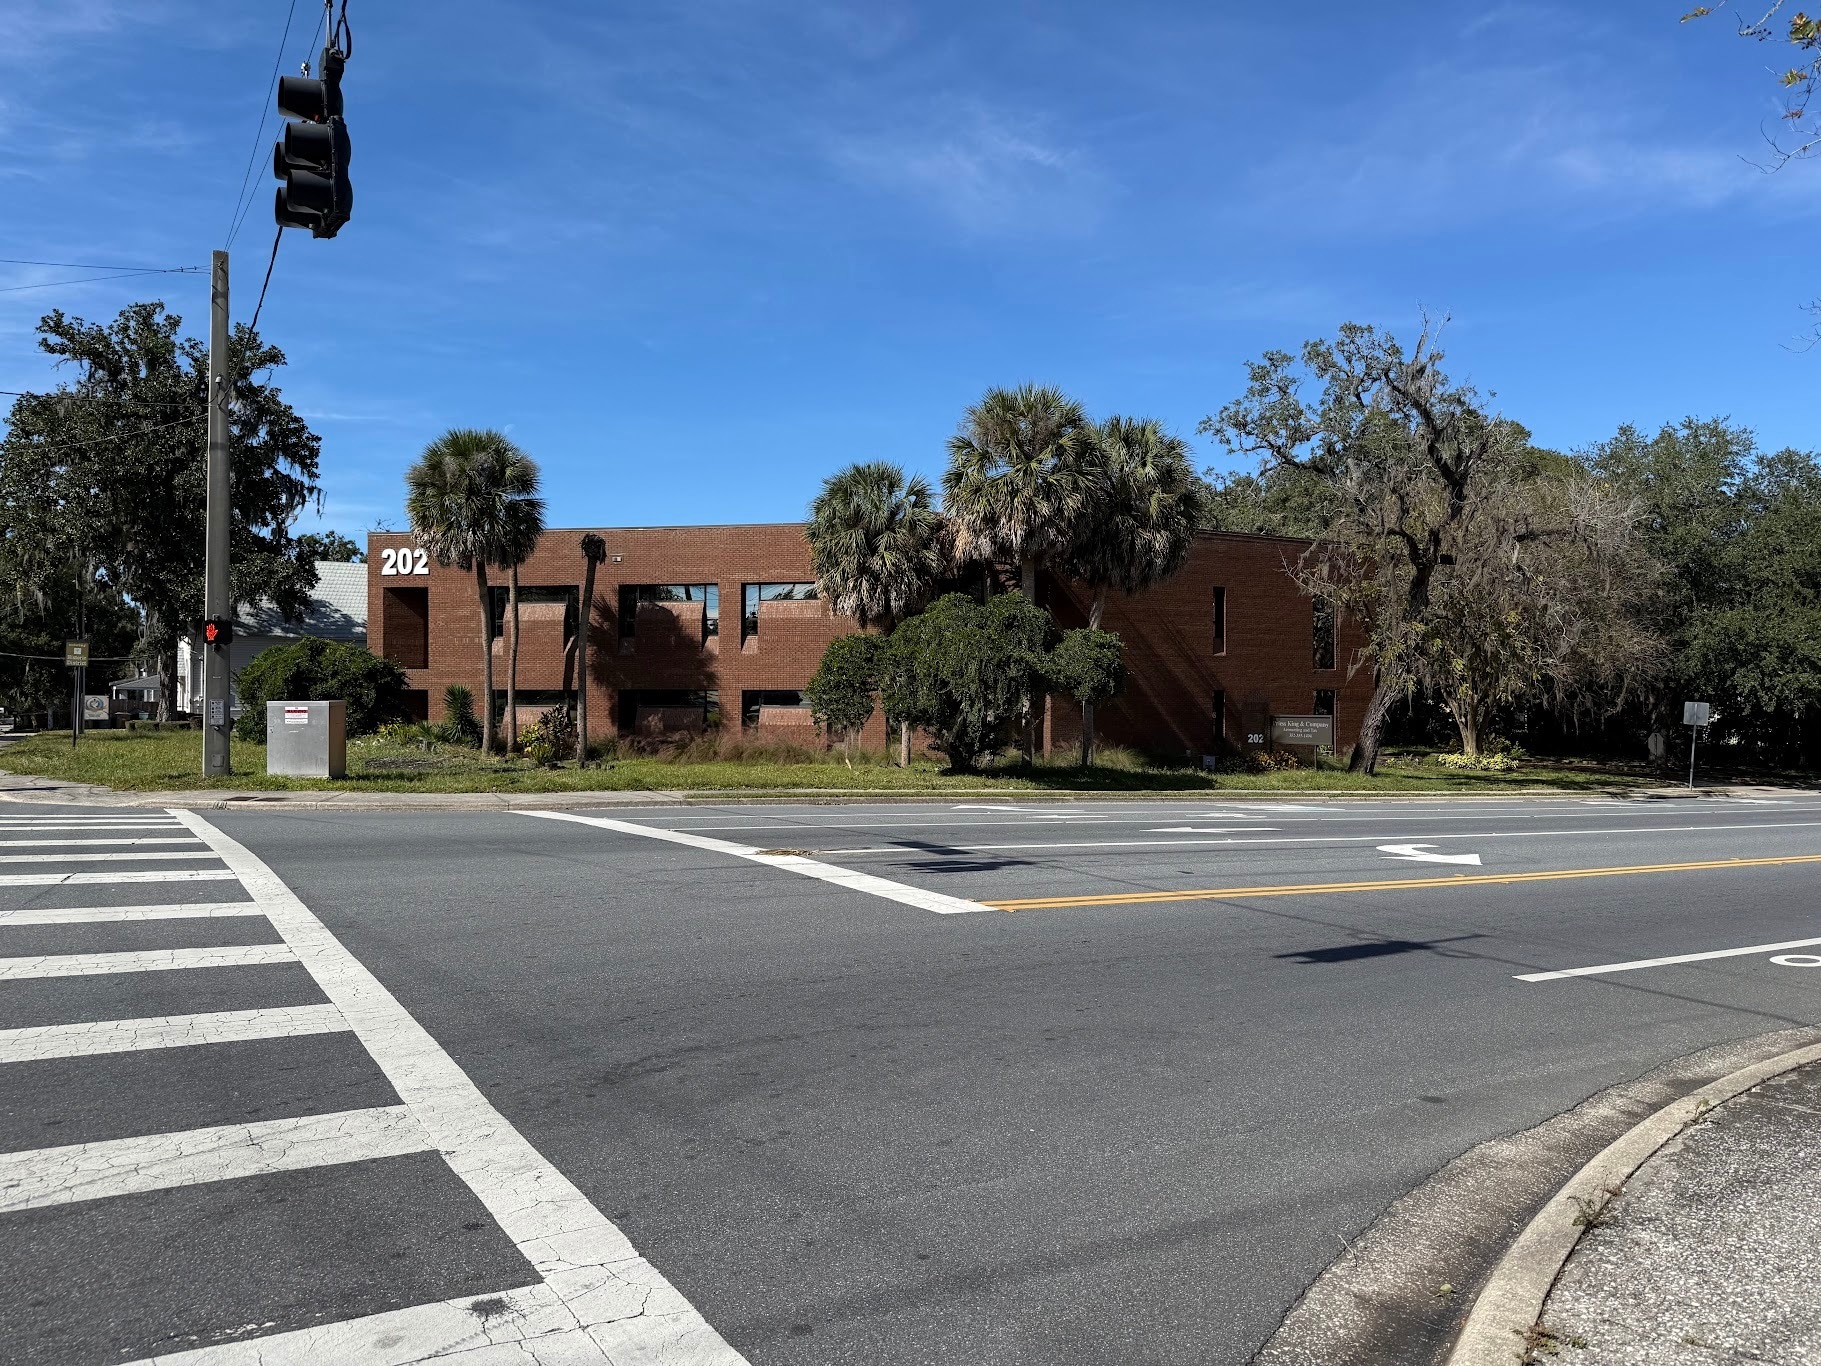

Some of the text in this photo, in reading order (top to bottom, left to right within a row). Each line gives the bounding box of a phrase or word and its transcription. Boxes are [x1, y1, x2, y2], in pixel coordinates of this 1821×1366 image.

[381, 547, 429, 575] 202
[1287, 720, 1300, 728] King
[1247, 734, 1264, 743] 202
